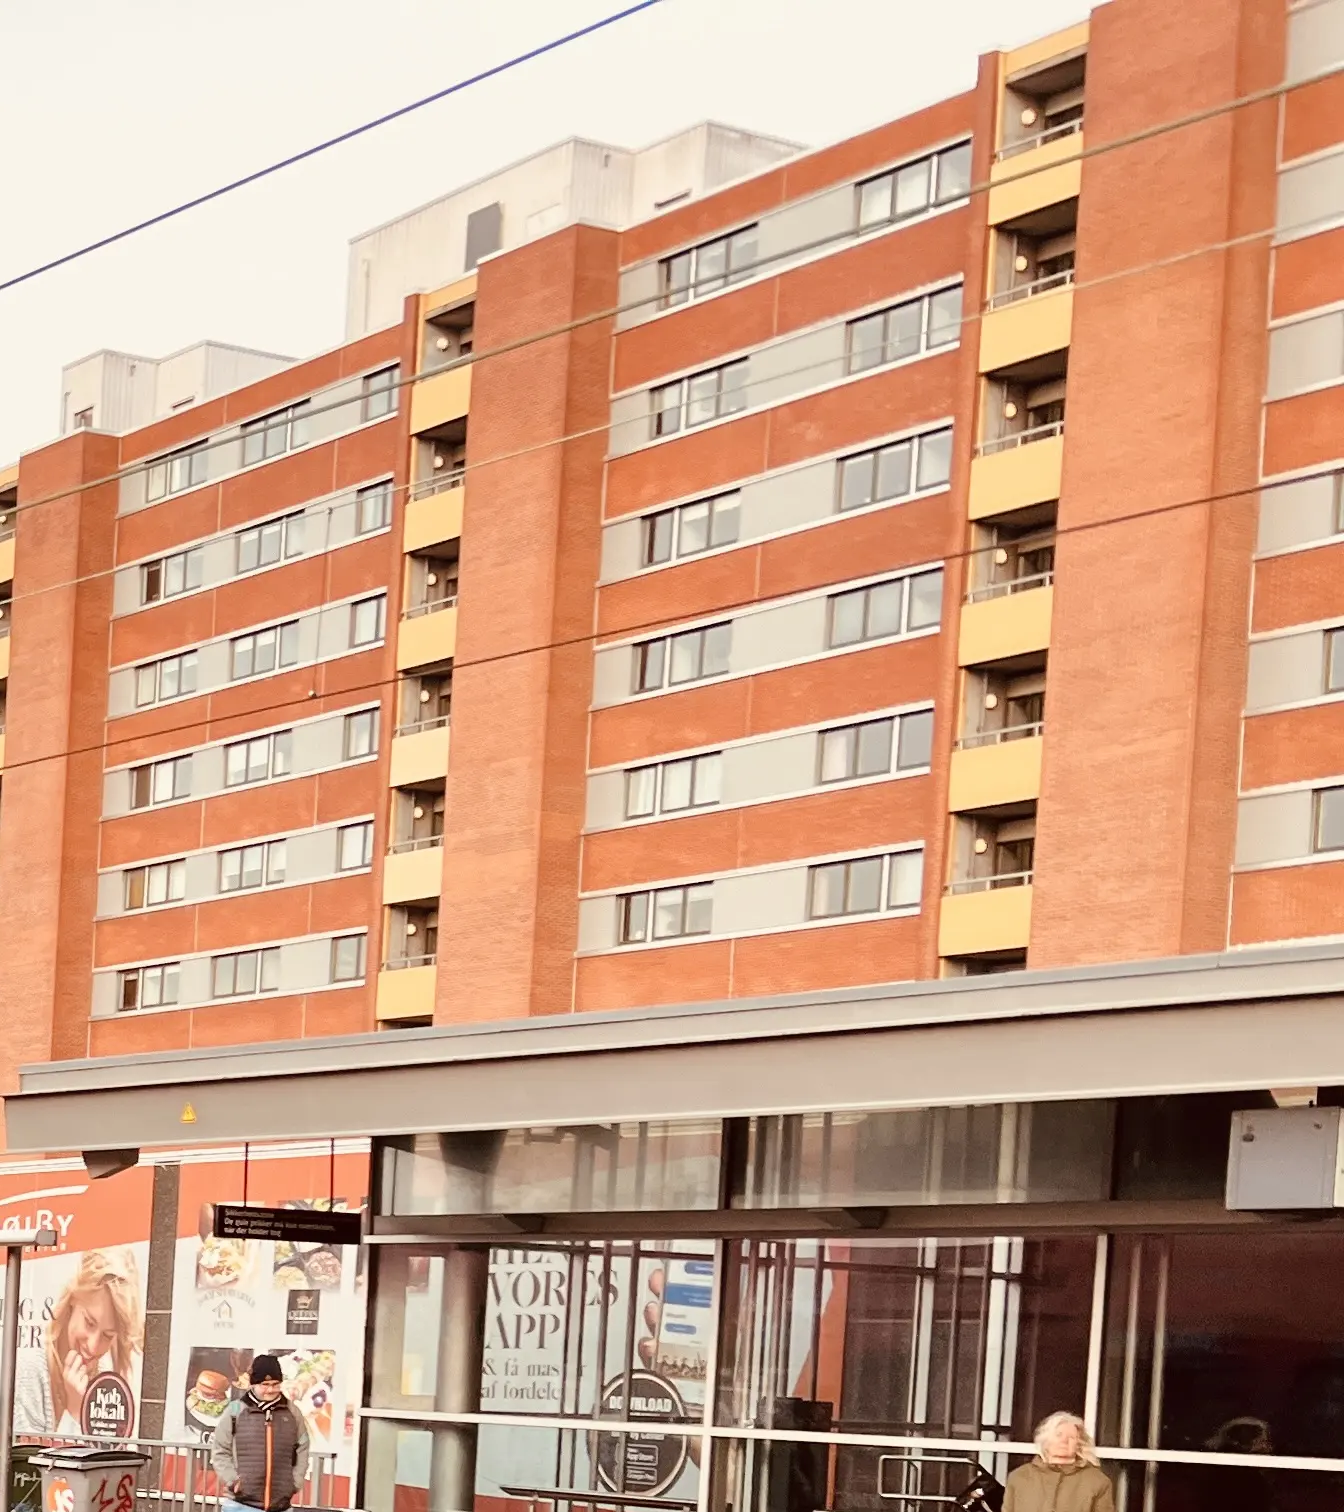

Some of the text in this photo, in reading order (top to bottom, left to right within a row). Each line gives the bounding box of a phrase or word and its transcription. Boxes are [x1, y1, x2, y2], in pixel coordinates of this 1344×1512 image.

[485, 1311, 561, 1350] APP
[482, 1358, 497, 1376] &
[609, 1395, 673, 1413] DONLOAD
